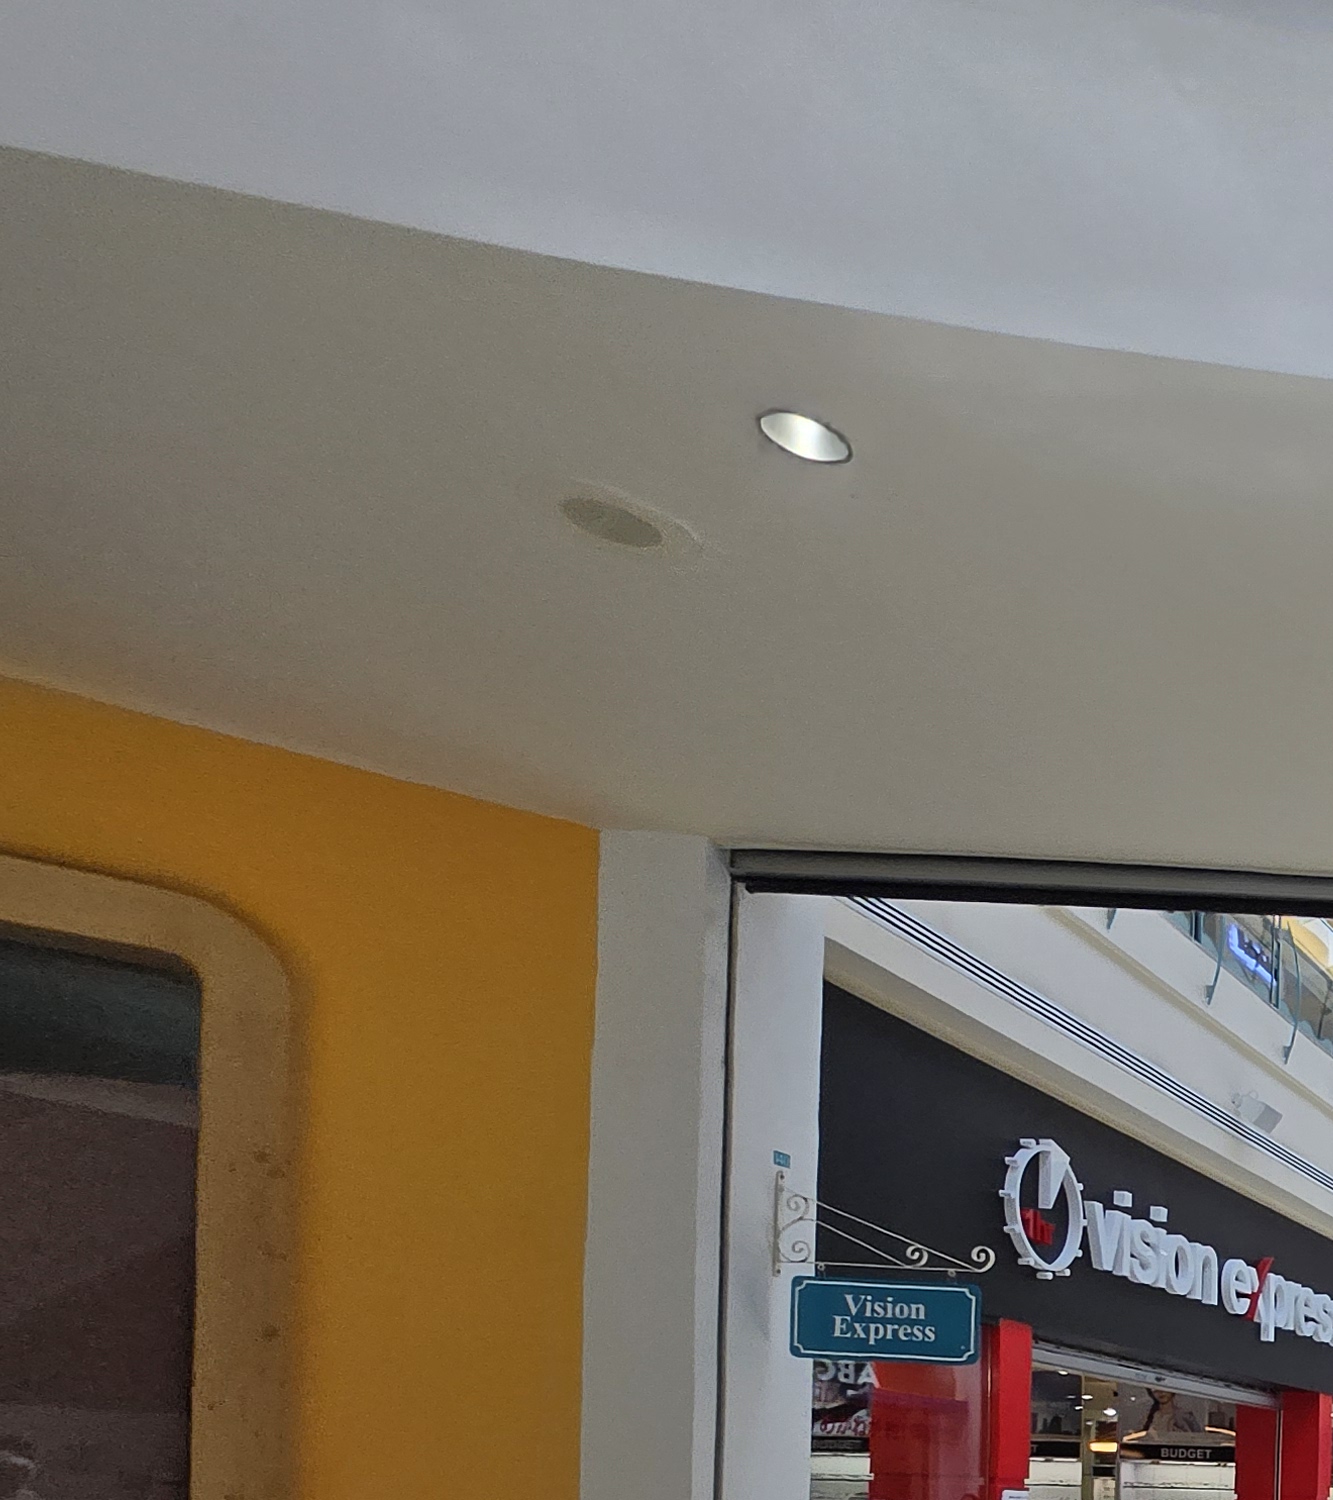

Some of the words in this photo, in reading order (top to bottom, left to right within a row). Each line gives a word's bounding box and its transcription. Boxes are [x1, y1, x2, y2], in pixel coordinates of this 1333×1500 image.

[1085, 1190, 1218, 1305] vision
[844, 1294, 926, 1320] Vision
[832, 1315, 936, 1345] Express
[1161, 1448, 1212, 1459] BUDGET
